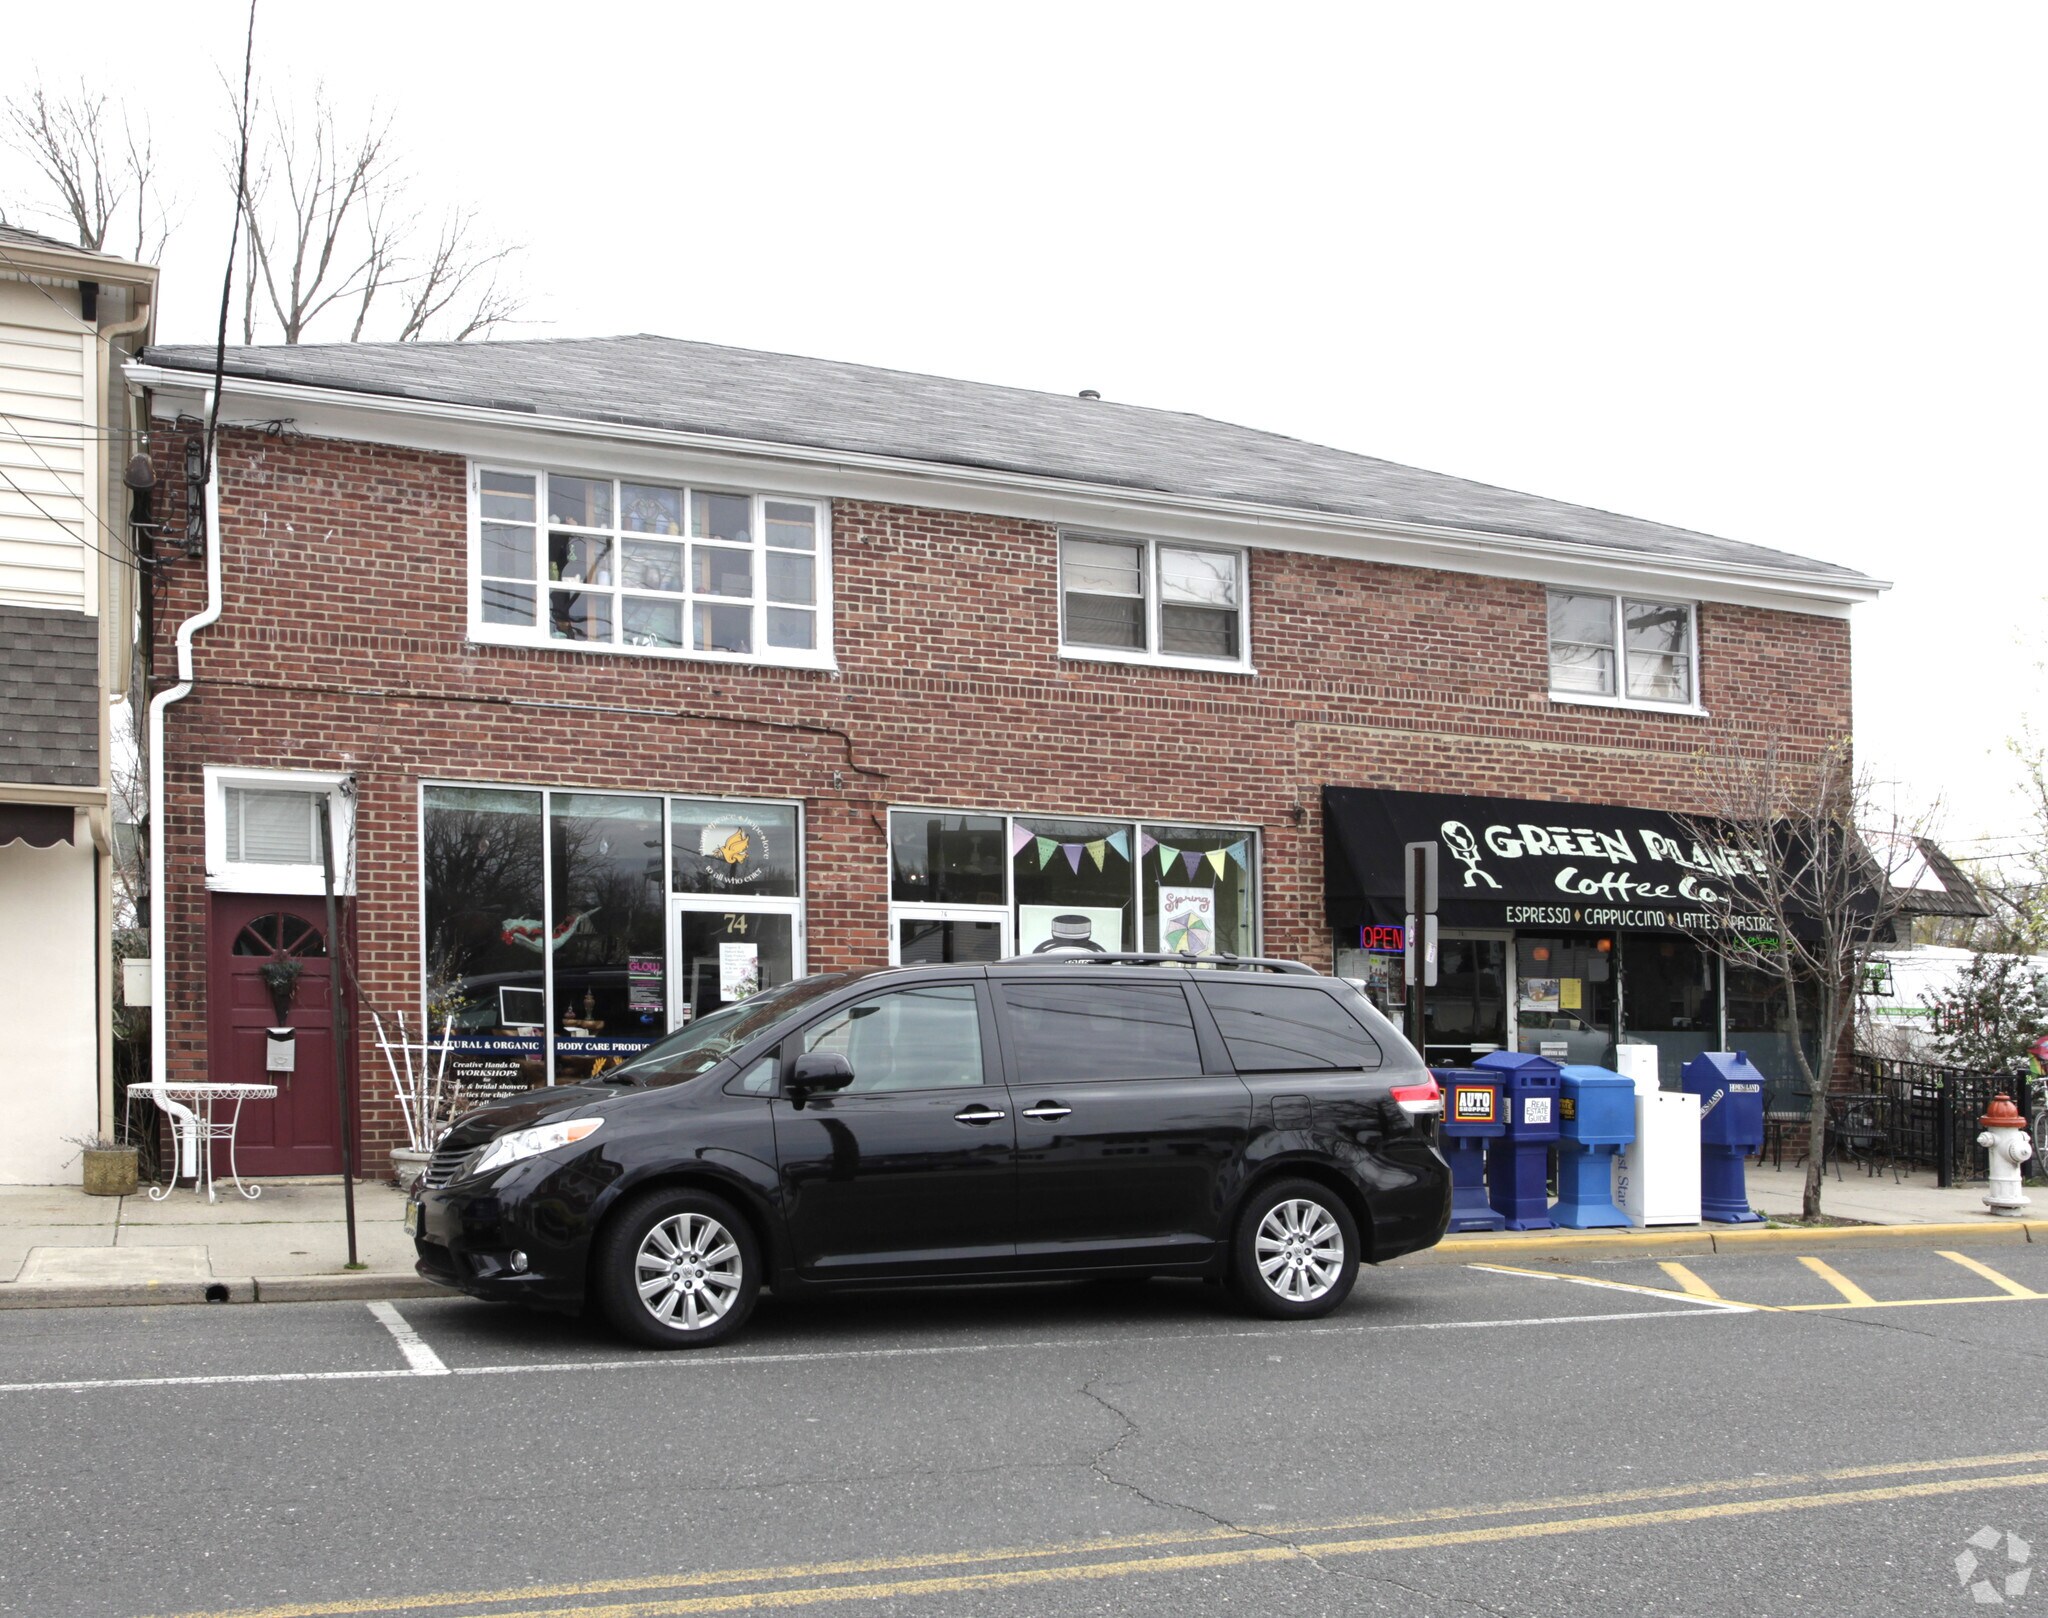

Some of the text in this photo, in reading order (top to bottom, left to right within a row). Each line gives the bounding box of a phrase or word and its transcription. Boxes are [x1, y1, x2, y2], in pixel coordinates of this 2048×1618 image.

[744, 815, 765, 836] hope
[761, 839, 770, 860] love
[1484, 823, 1770, 879] GREEN PLANET
[705, 865, 762, 885] to all who enter
[1554, 866, 1677, 903] Coffee
[1164, 892, 1211, 913] Spring
[723, 913, 748, 935] 74
[1506, 906, 1776, 932] ESPRESSO CAPPUCCINO LATTES PASTRIE
[1363, 926, 1404, 950] OPEN
[628, 962, 661, 972] GLOW
[484, 1041, 491, 1050] &
[492, 1041, 541, 1051] ORGANIC
[557, 1042, 584, 1051] BODY
[585, 1042, 610, 1051] CARE
[453, 1061, 483, 1069] Creative
[484, 1061, 509, 1069] Hands
[456, 1069, 518, 1077] WORKSHOPS
[475, 1082, 498, 1090] bridal
[498, 1083, 528, 1091] showers
[479, 1091, 492, 1099] for
[1459, 1091, 1490, 1107] AUTO
[1526, 1107, 1549, 1116] ESTATE
[1531, 1100, 1548, 1109] REAL
[1528, 1114, 1549, 1122] GUIDE
[1617, 1175, 1630, 1207] Star
